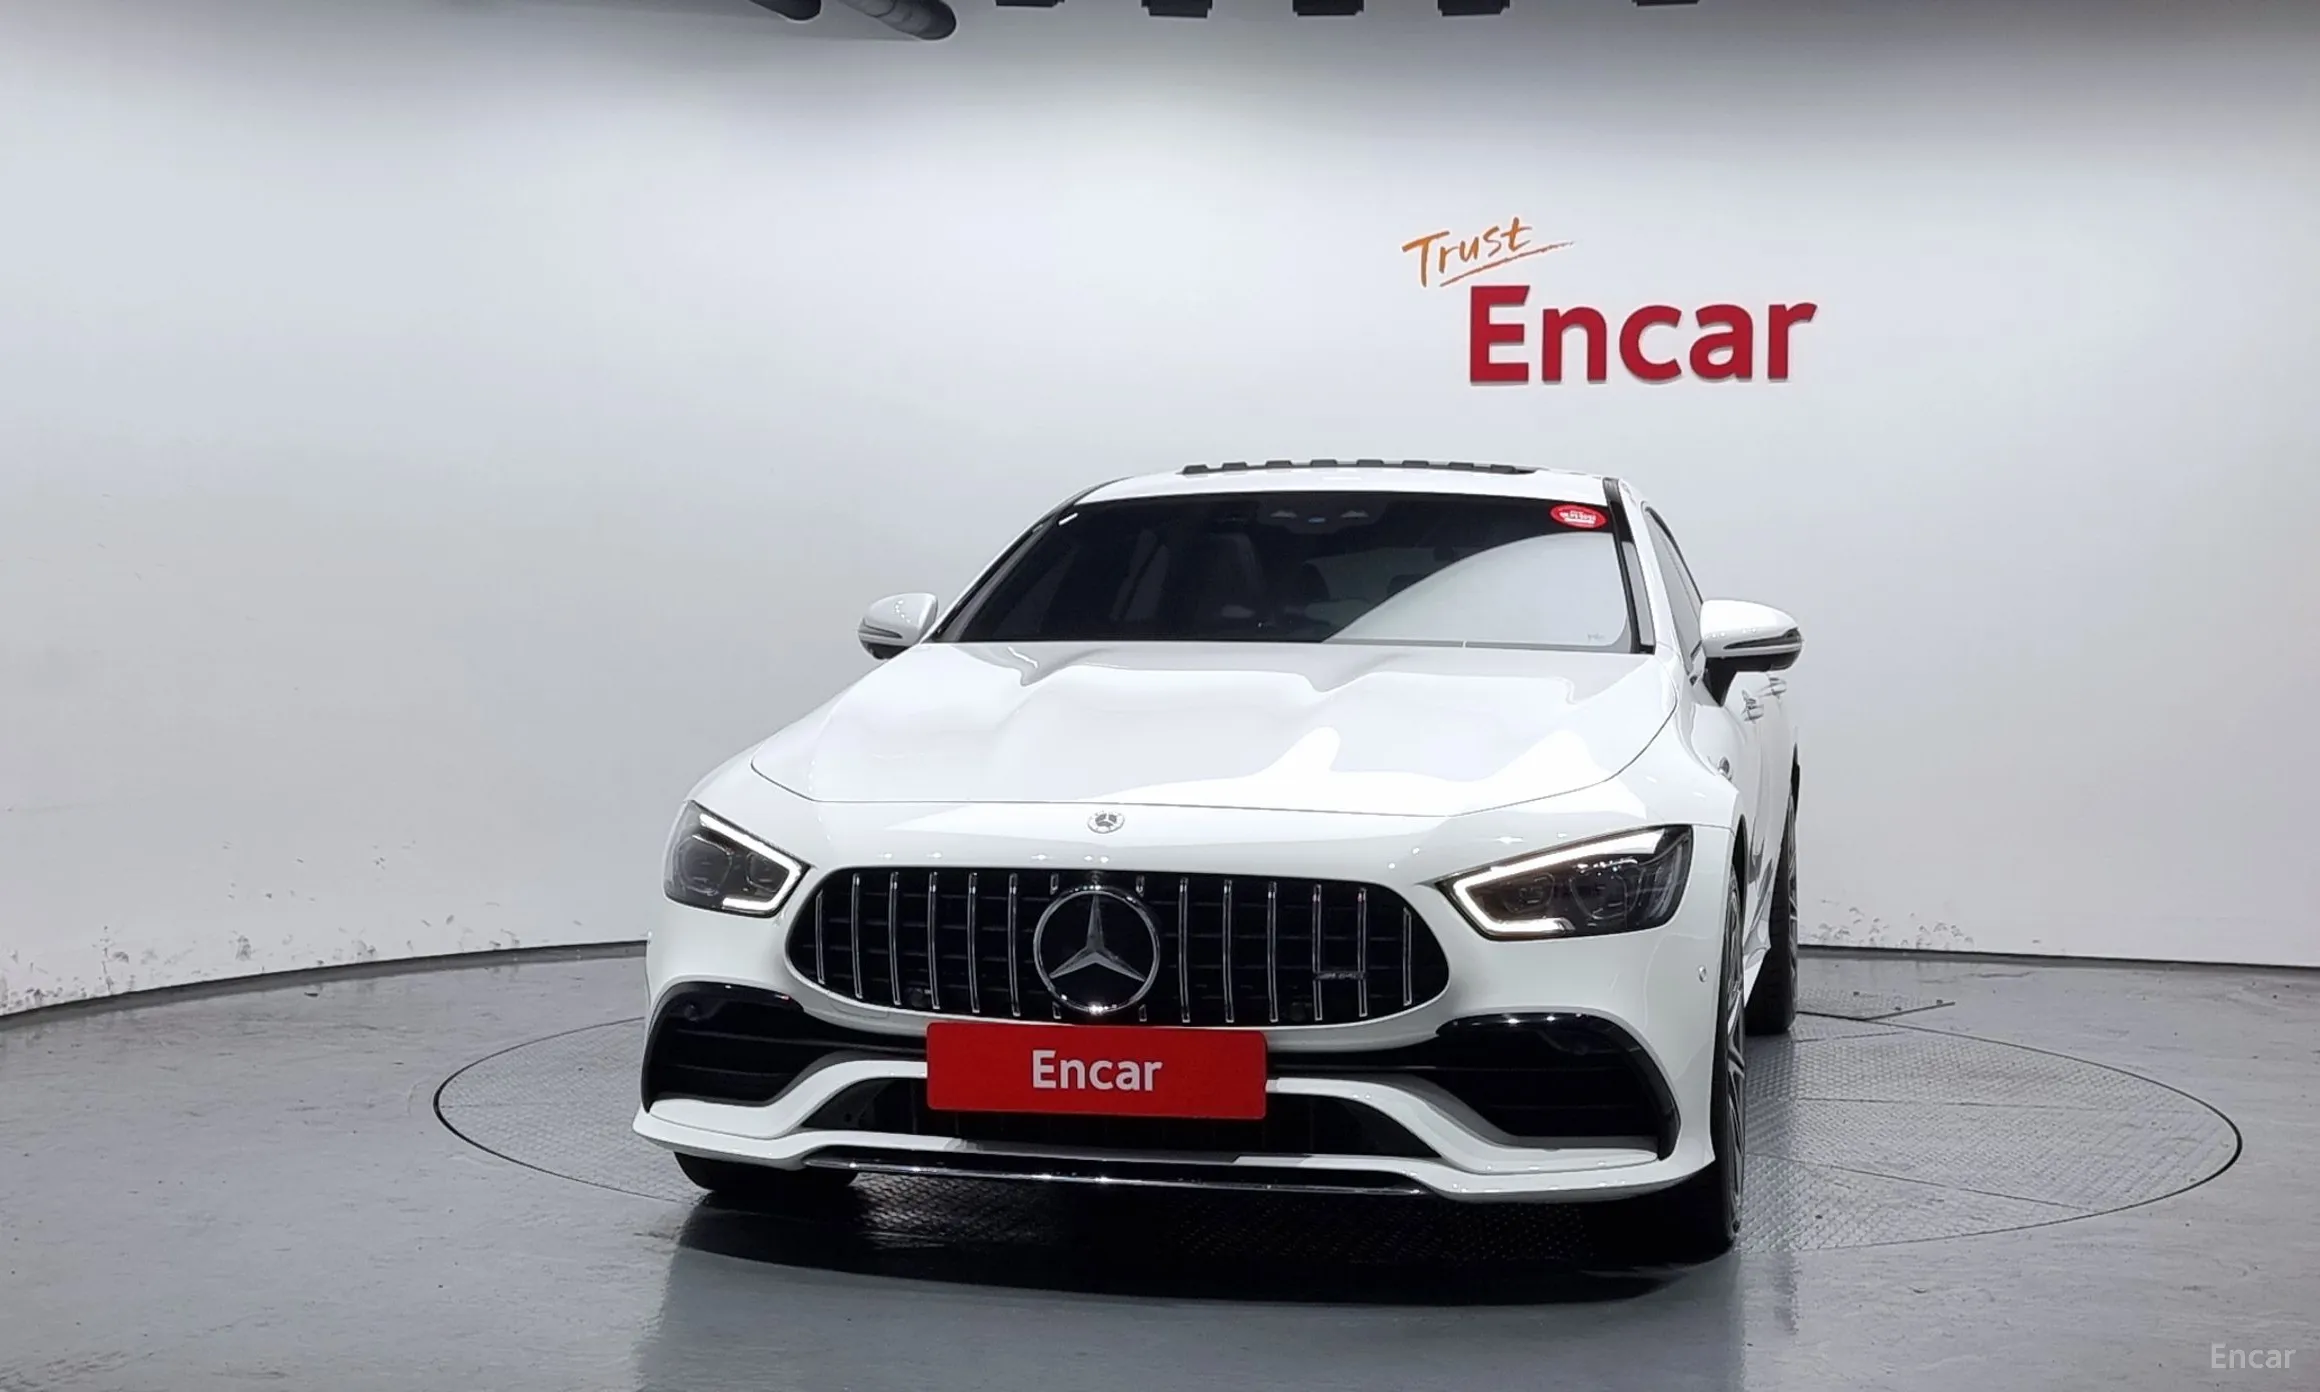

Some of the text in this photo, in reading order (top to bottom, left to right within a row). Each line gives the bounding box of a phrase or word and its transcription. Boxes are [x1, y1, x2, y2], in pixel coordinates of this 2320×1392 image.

[1402, 217, 1533, 287] Trust
[1470, 285, 1818, 383] Encar
[1032, 1050, 1162, 1091] Encar
